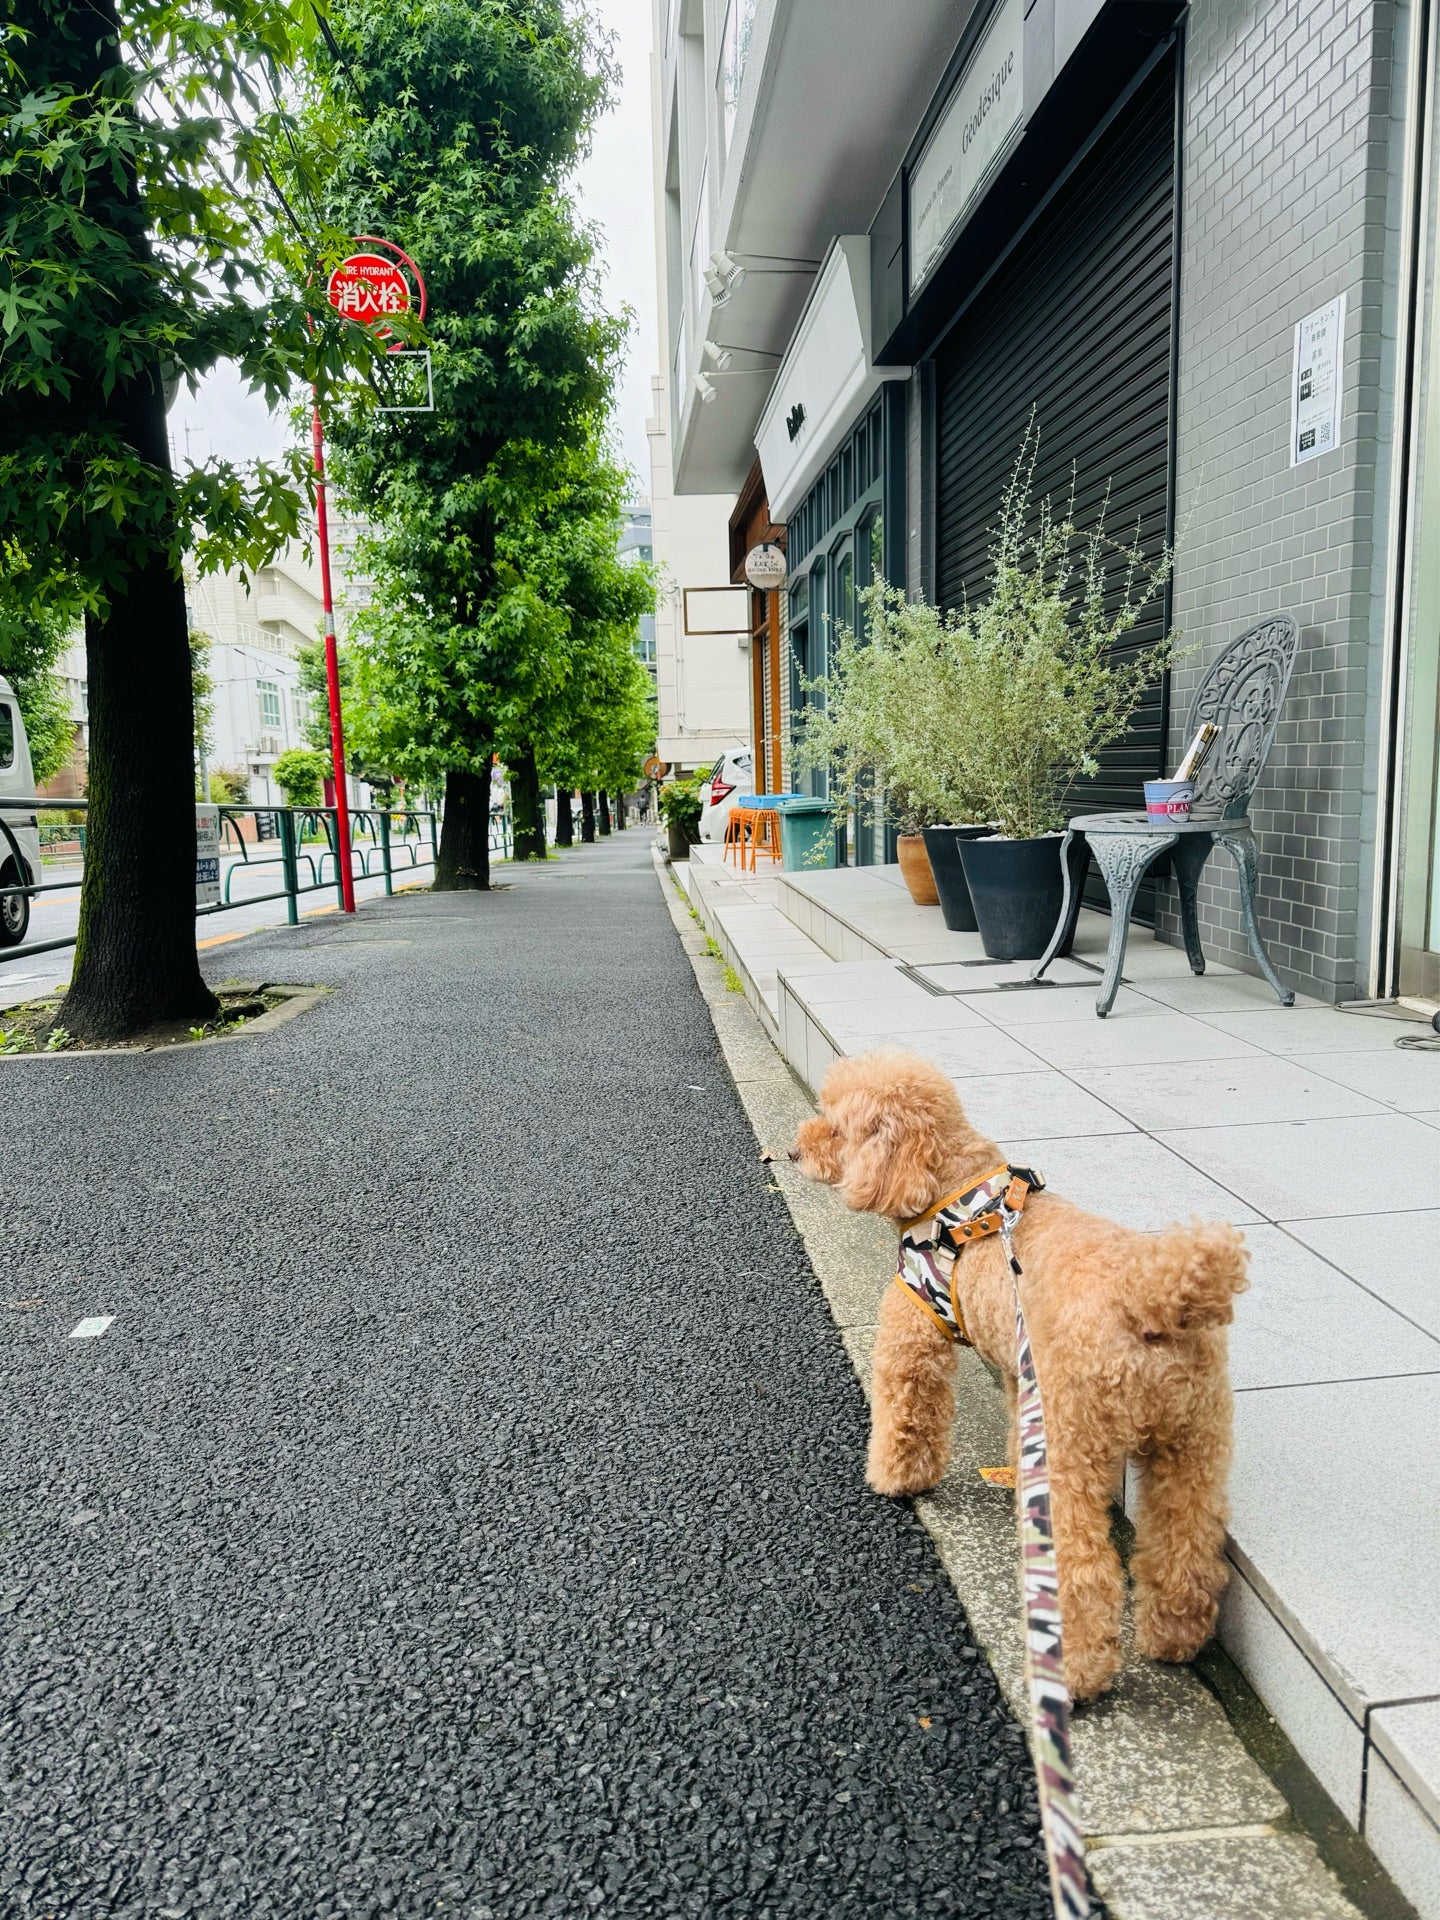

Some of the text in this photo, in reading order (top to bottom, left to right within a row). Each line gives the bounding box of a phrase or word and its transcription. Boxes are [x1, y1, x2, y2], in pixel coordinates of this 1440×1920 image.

[359, 266, 395, 277] HYDRANT
[335, 280, 403, 313] 消火栓
